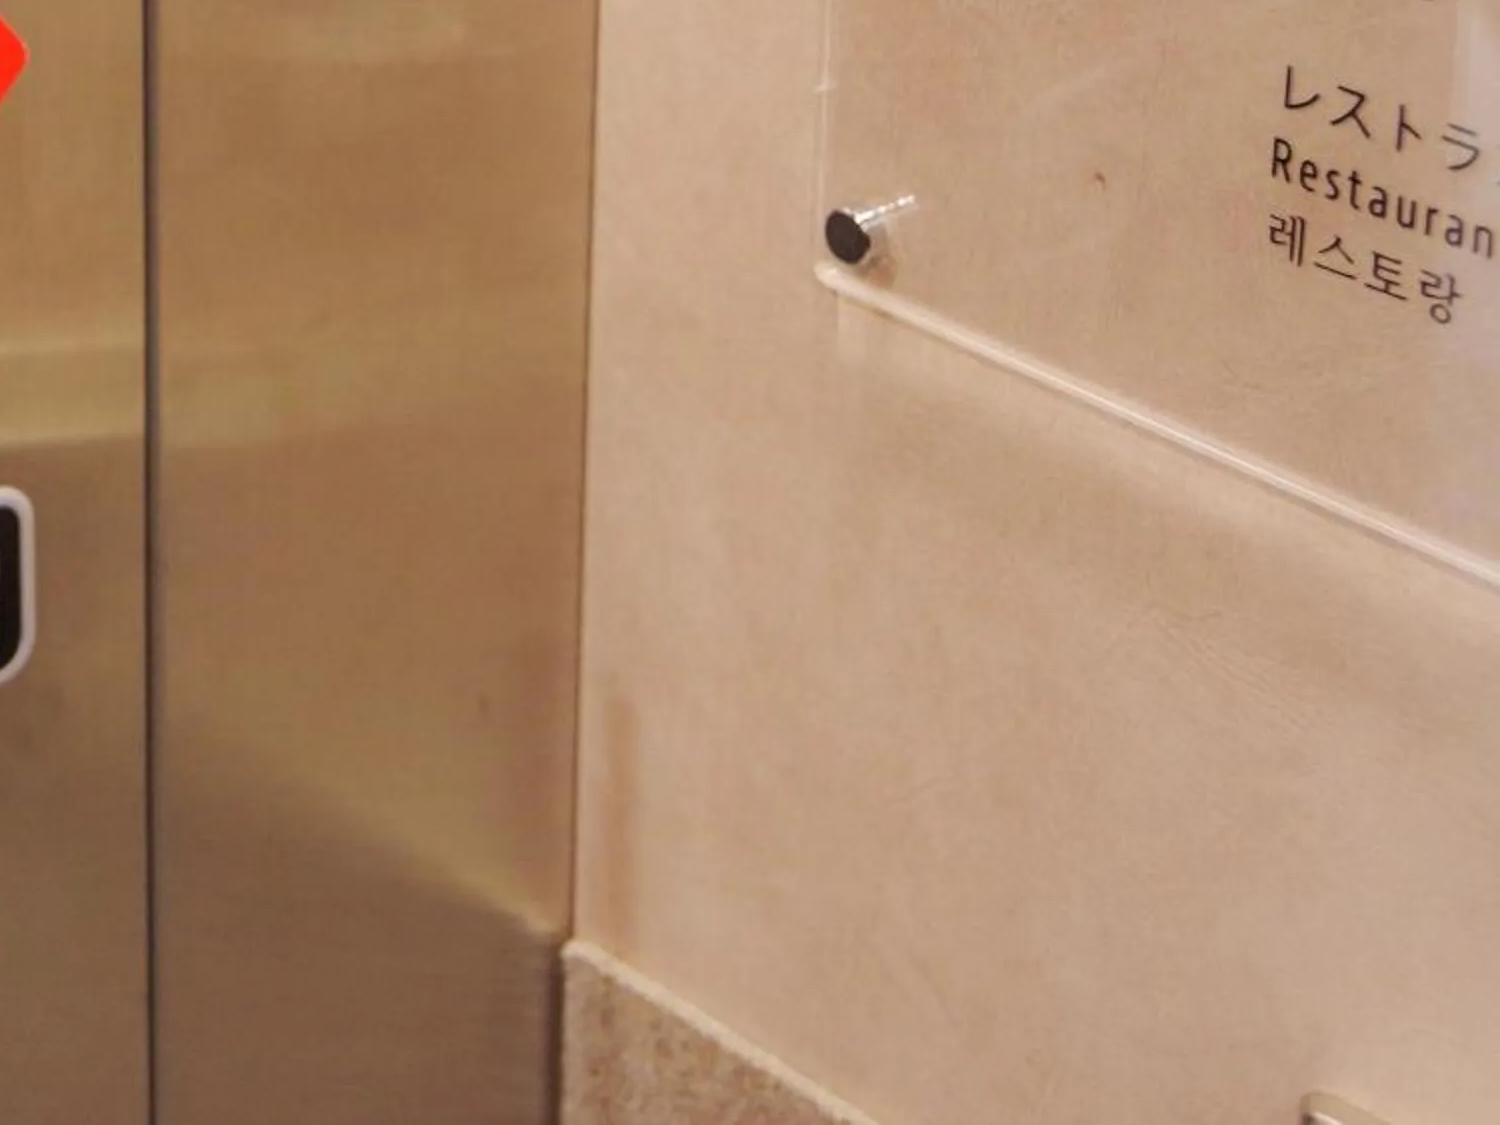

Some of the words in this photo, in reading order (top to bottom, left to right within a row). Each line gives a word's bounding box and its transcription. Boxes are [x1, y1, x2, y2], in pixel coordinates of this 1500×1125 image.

[1282, 65, 1500, 187] レストラ
[1270, 136, 1496, 261] Restauran
[1268, 213, 1462, 325] 레스토랑
